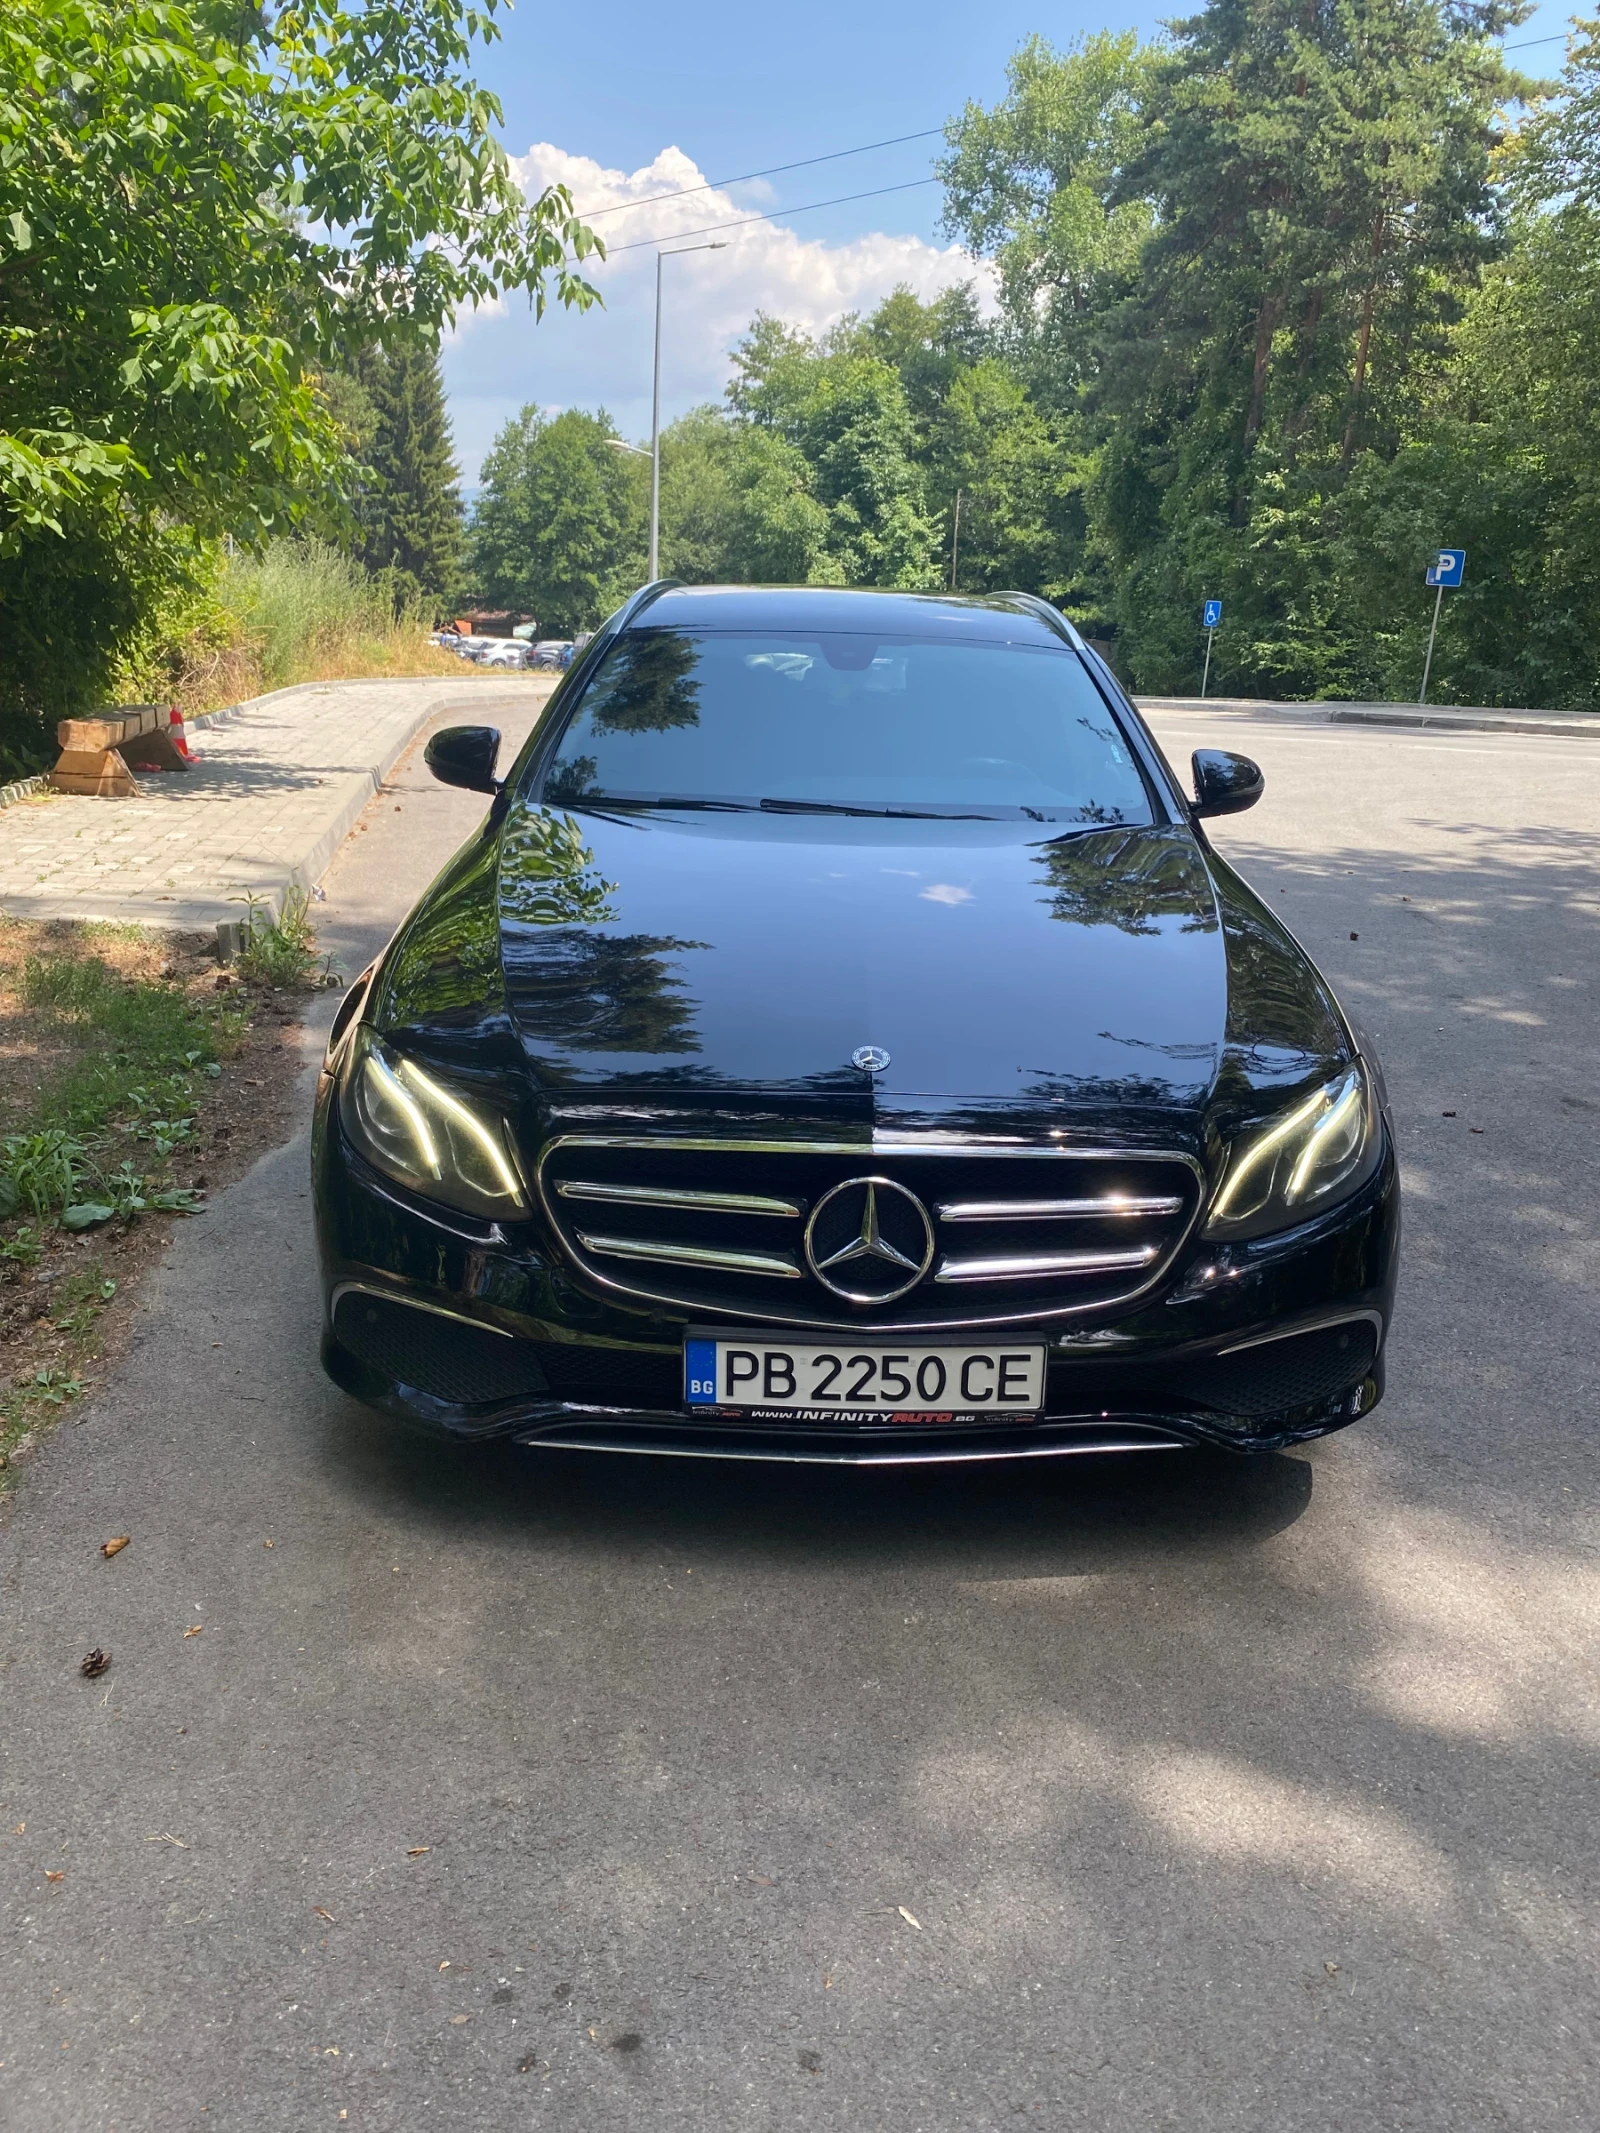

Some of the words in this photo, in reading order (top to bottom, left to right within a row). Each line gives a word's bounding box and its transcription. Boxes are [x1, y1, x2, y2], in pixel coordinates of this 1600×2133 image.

[1435, 554, 1456, 581] P
[690, 1379, 713, 1395] BG
[726, 1350, 796, 1399] PB
[811, 1354, 947, 1402] 2250
[961, 1354, 1032, 1402] CE
